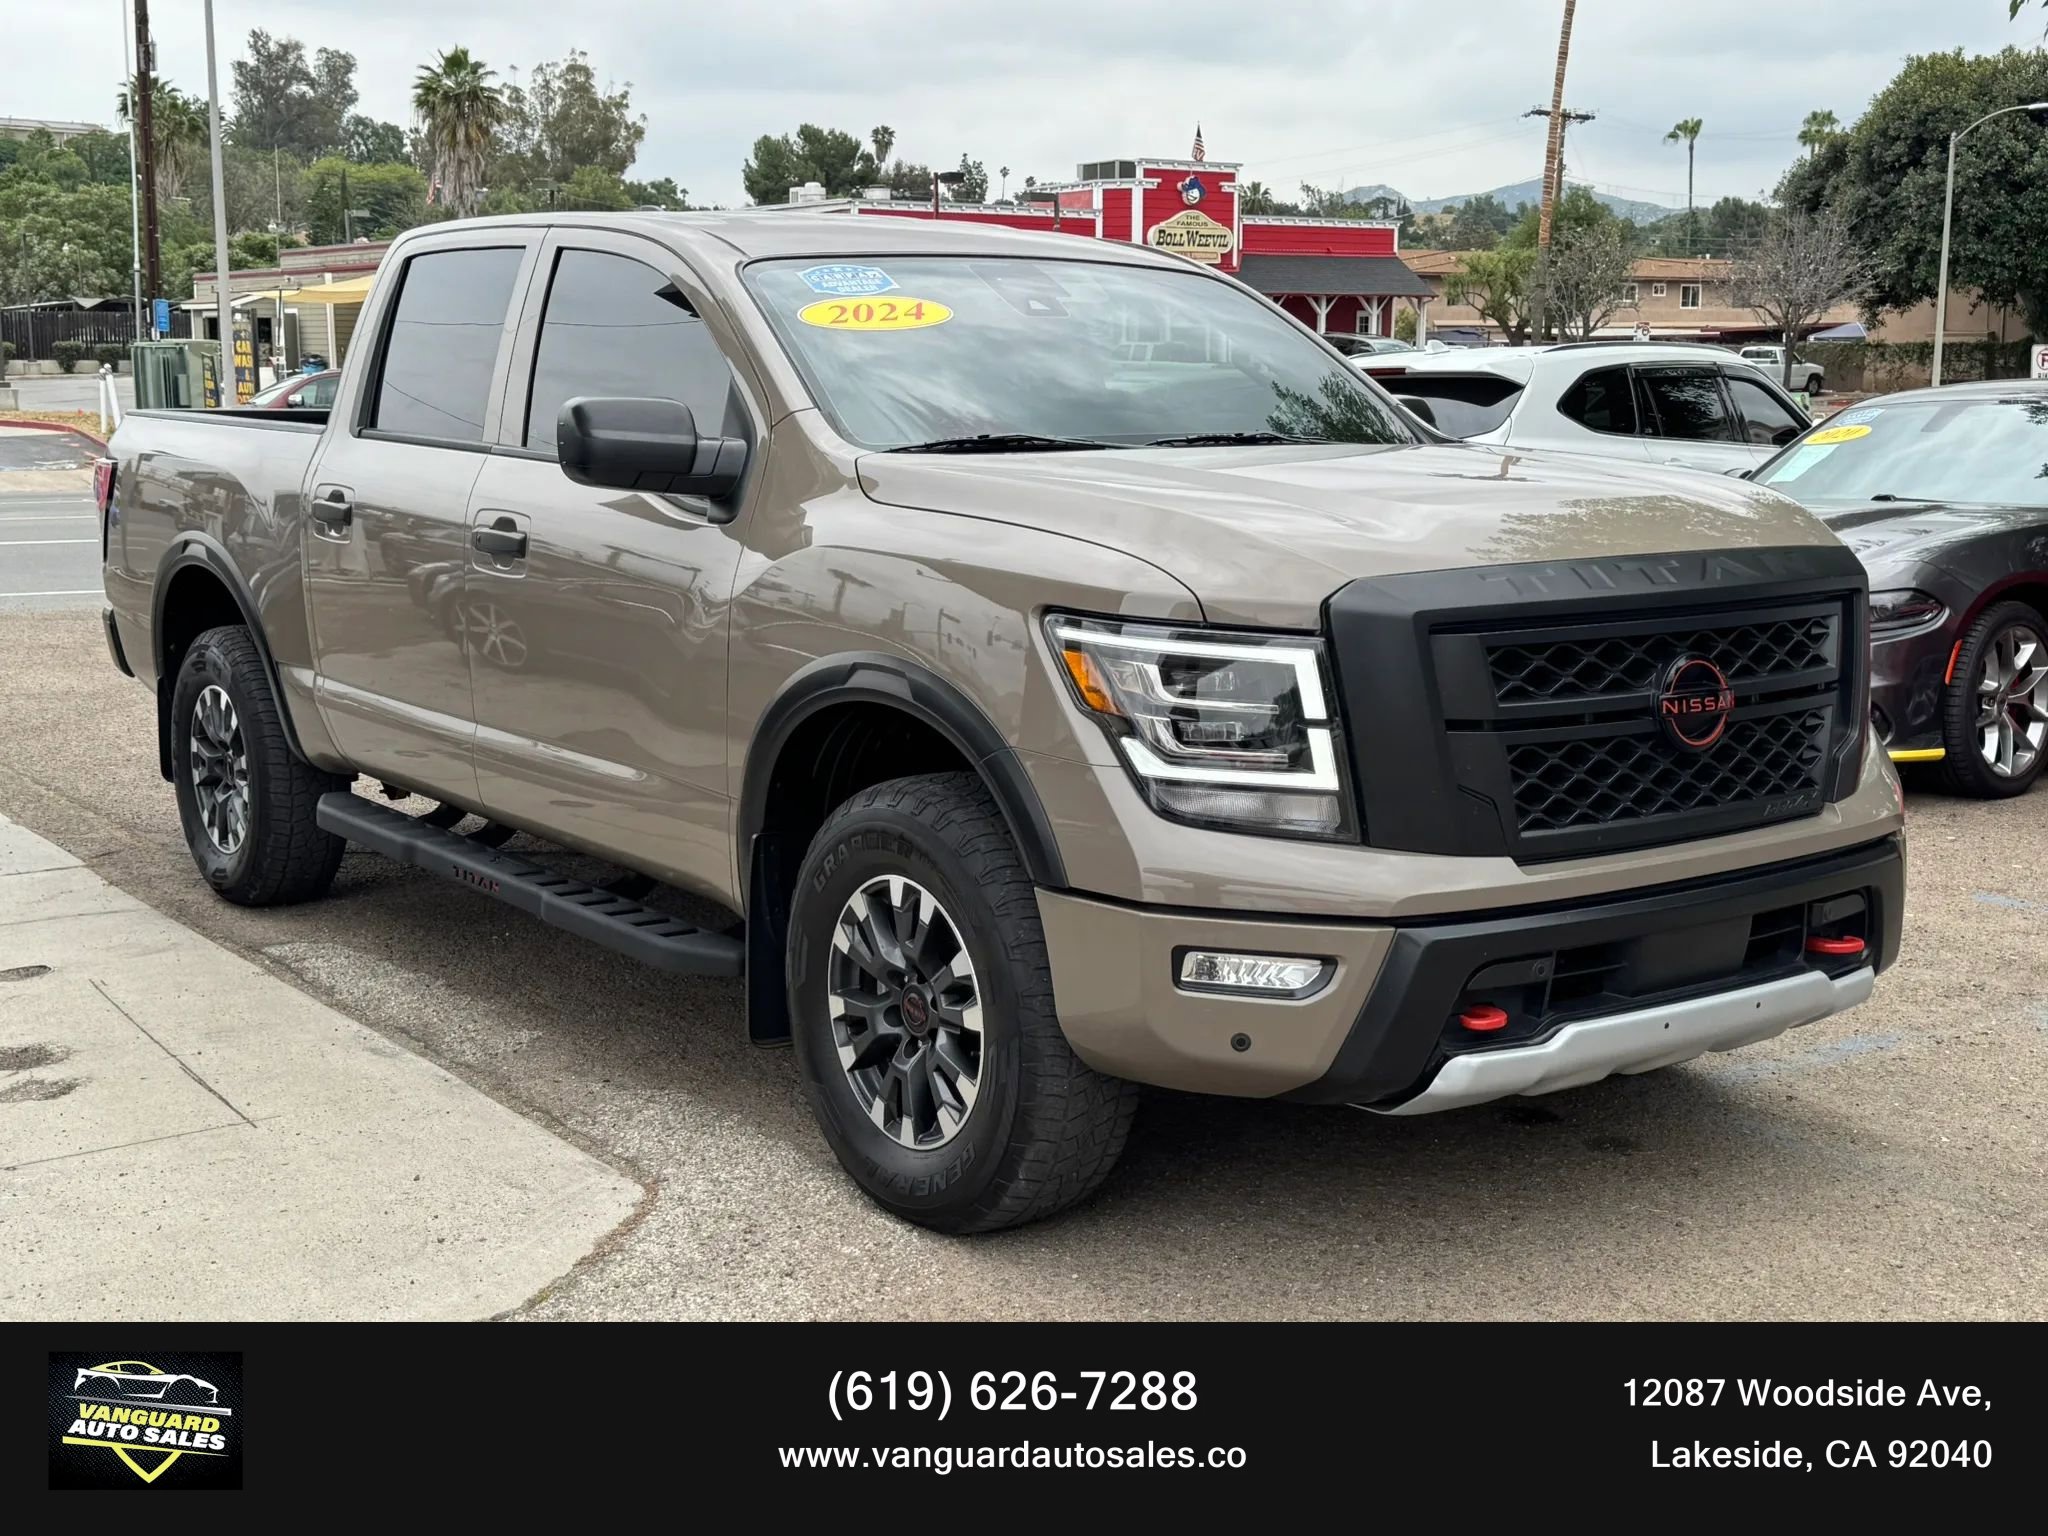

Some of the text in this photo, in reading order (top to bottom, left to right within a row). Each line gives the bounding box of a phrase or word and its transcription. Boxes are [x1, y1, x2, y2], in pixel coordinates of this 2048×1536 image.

[1155, 229, 1229, 247] BOLL WEEVIL
[828, 302, 925, 324] 2024
[1661, 690, 1735, 715] NISSAN
